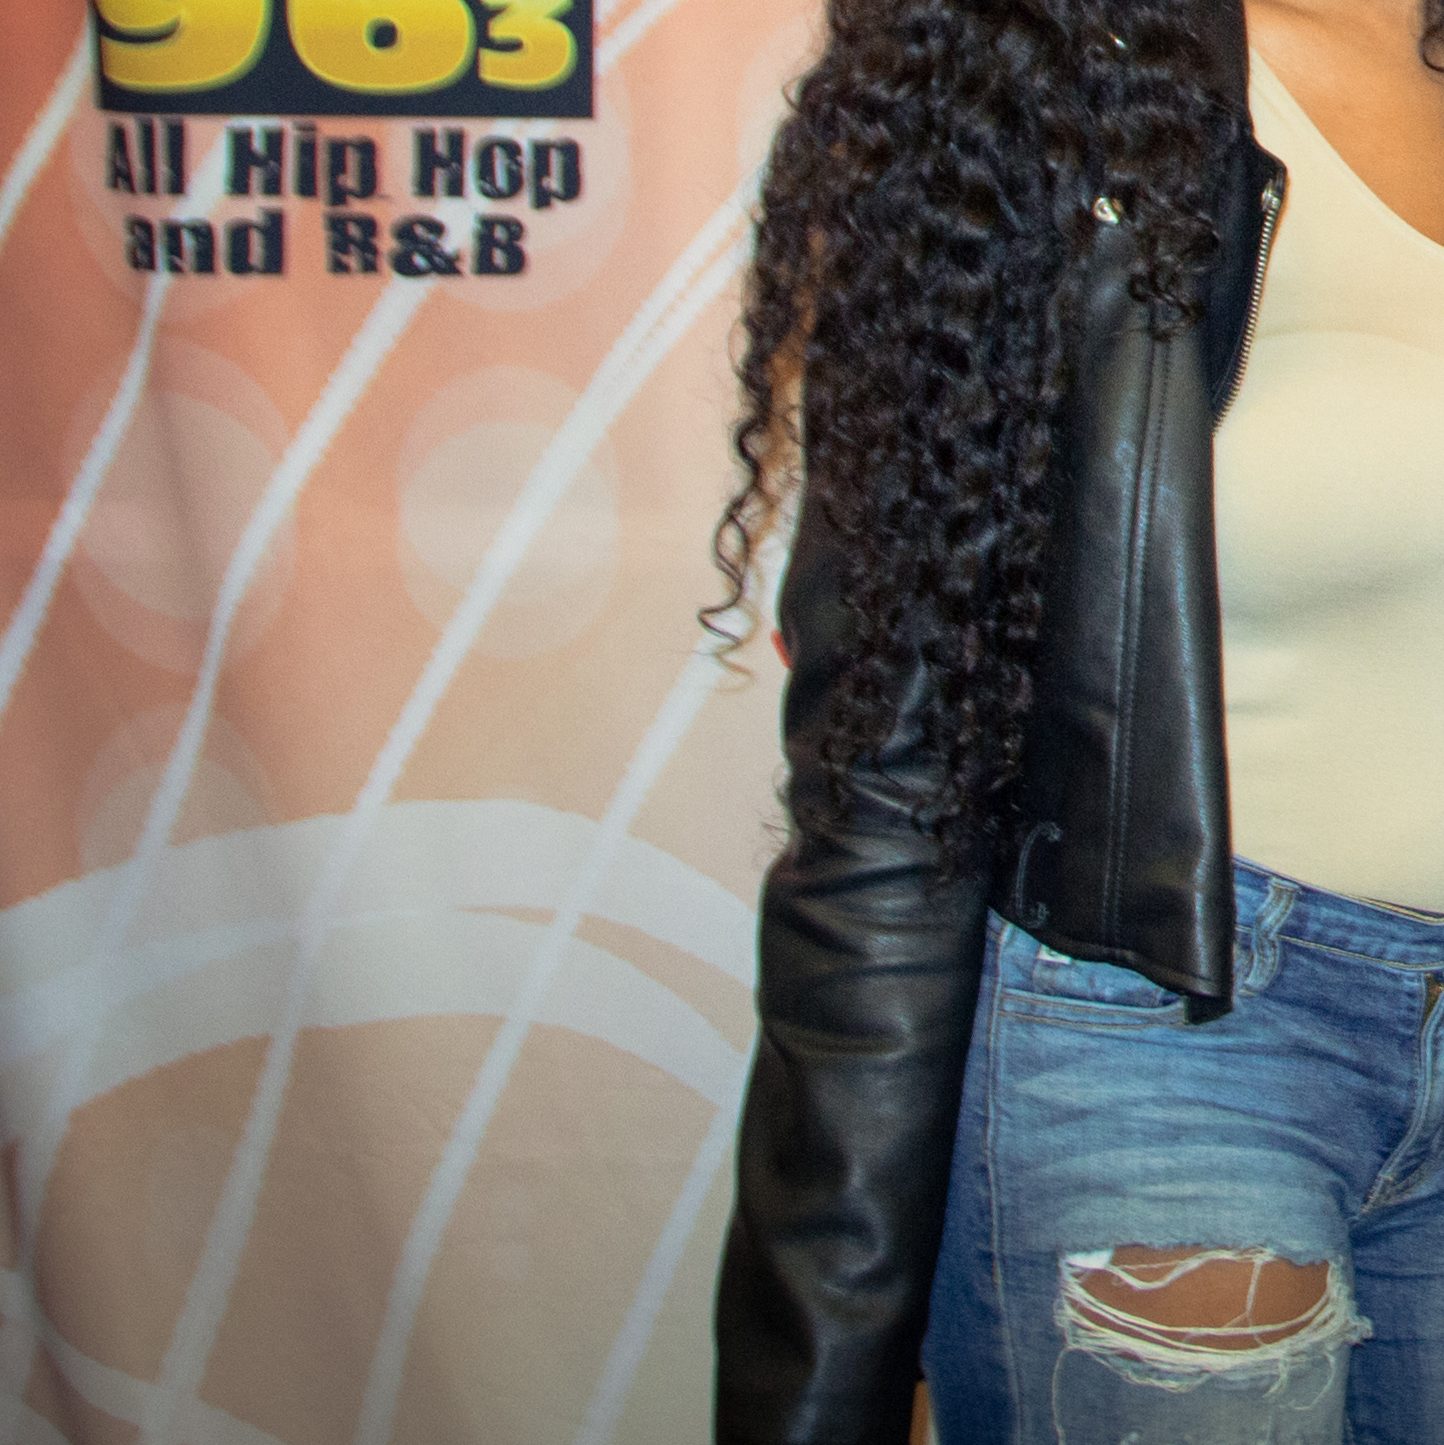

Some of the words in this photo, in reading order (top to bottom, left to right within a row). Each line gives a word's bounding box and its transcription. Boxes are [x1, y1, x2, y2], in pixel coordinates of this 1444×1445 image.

[105, 116, 187, 196] All
[224, 121, 379, 207] Hip
[411, 125, 582, 209] Hop
[125, 207, 286, 275] and
[324, 209, 529, 278] R&B
